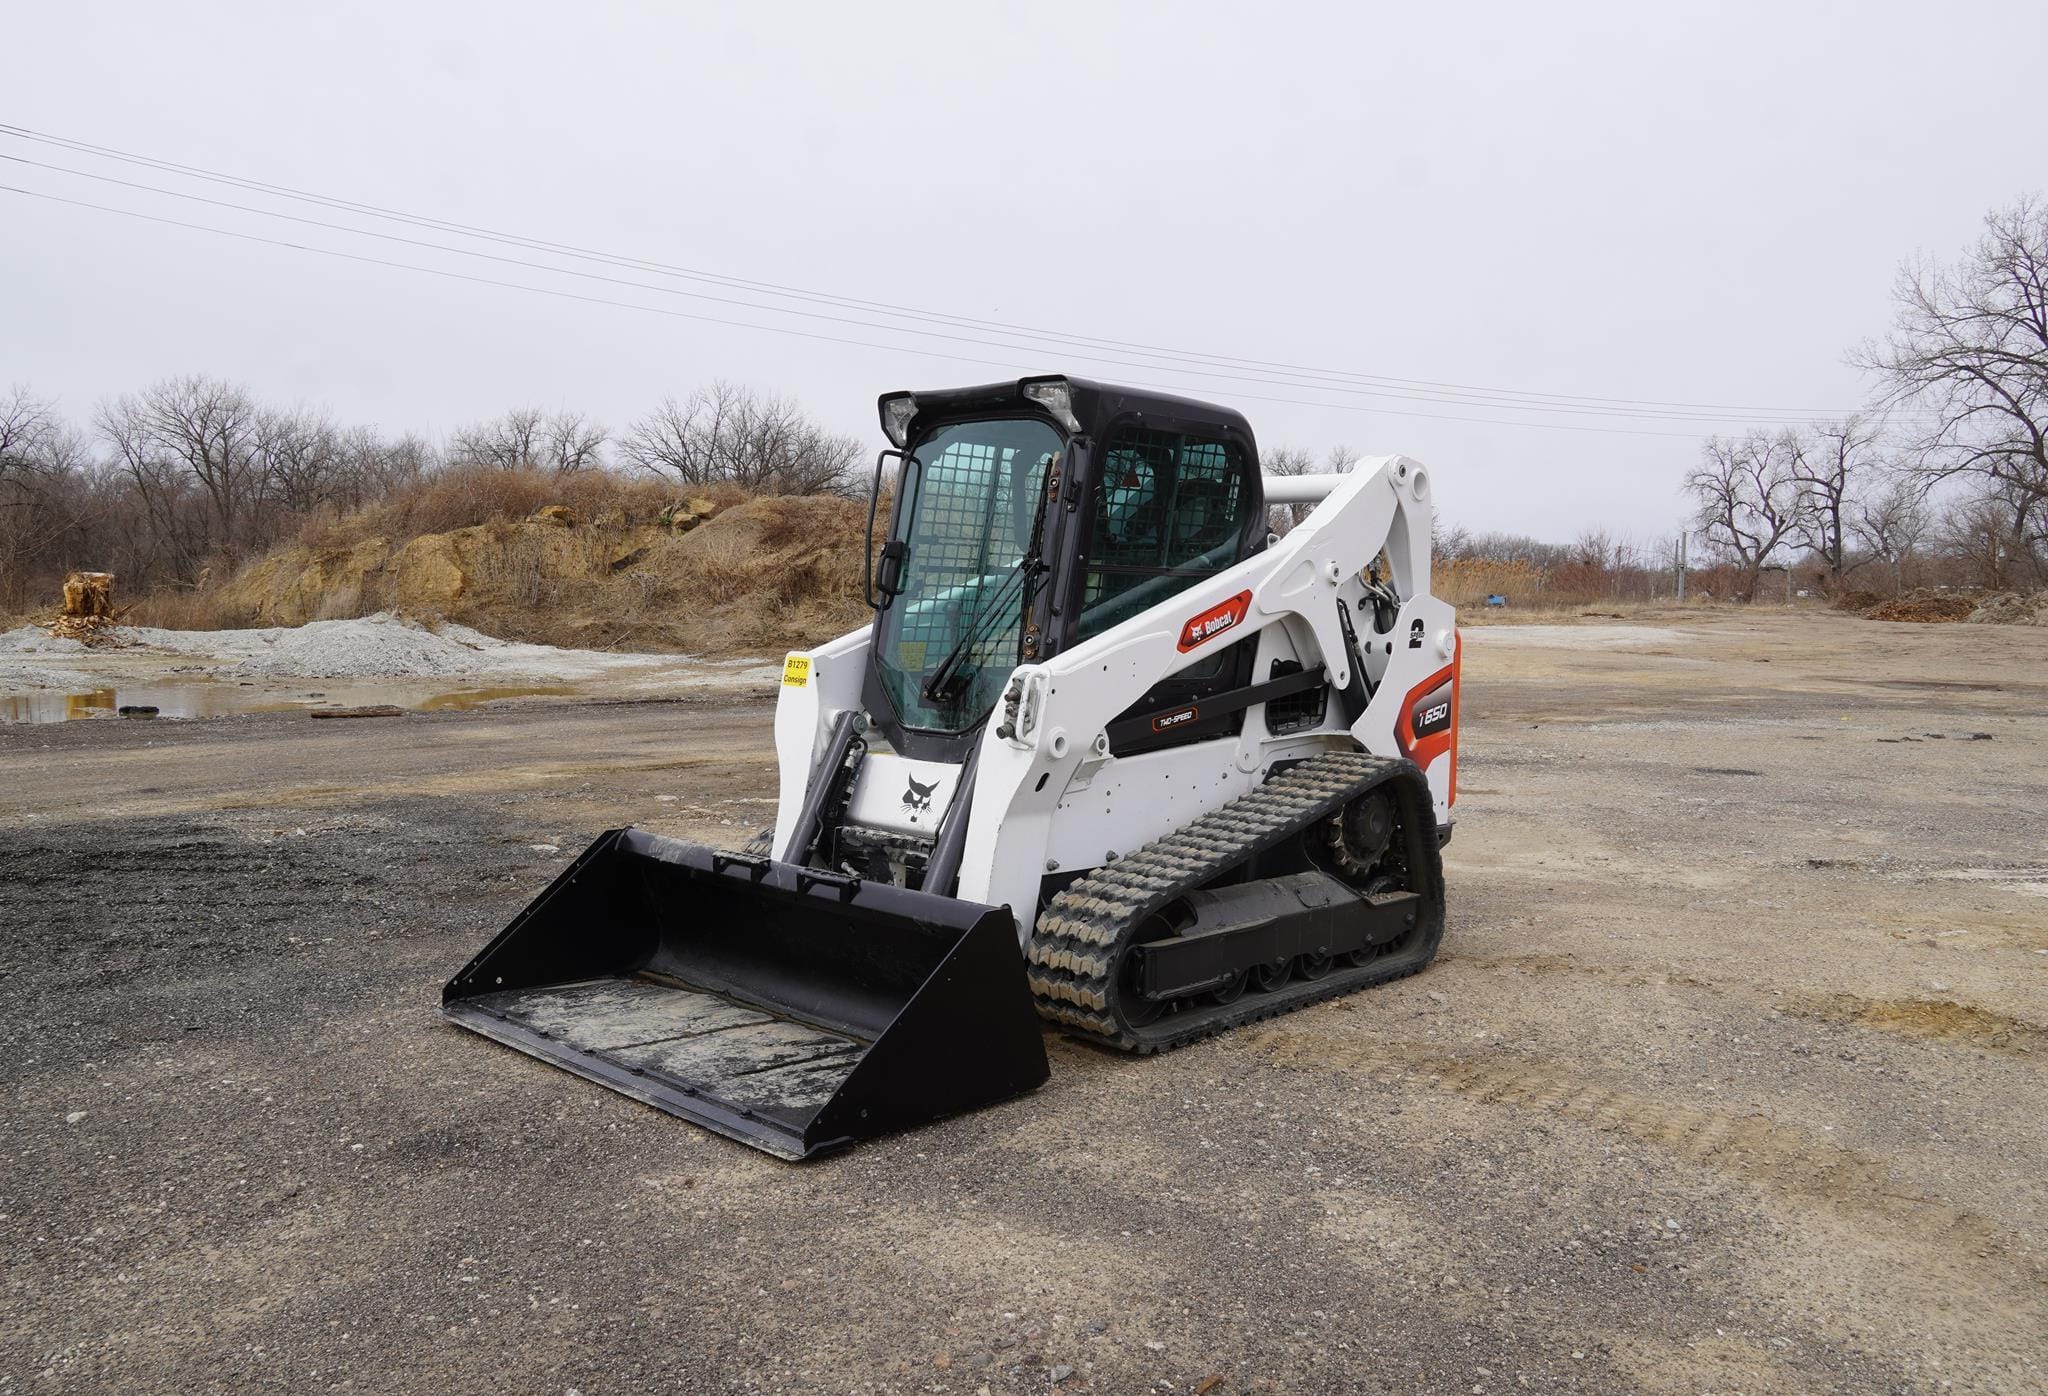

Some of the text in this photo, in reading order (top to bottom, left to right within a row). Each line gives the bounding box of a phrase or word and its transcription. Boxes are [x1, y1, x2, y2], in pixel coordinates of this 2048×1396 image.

[1205, 610, 1232, 635] Bobcat
[1409, 619, 1424, 648] 2
[788, 660, 808, 669] B1279
[784, 675, 806, 686] Consign
[1160, 711, 1192, 727] TWO-SPEED
[1419, 703, 1447, 727] T650
